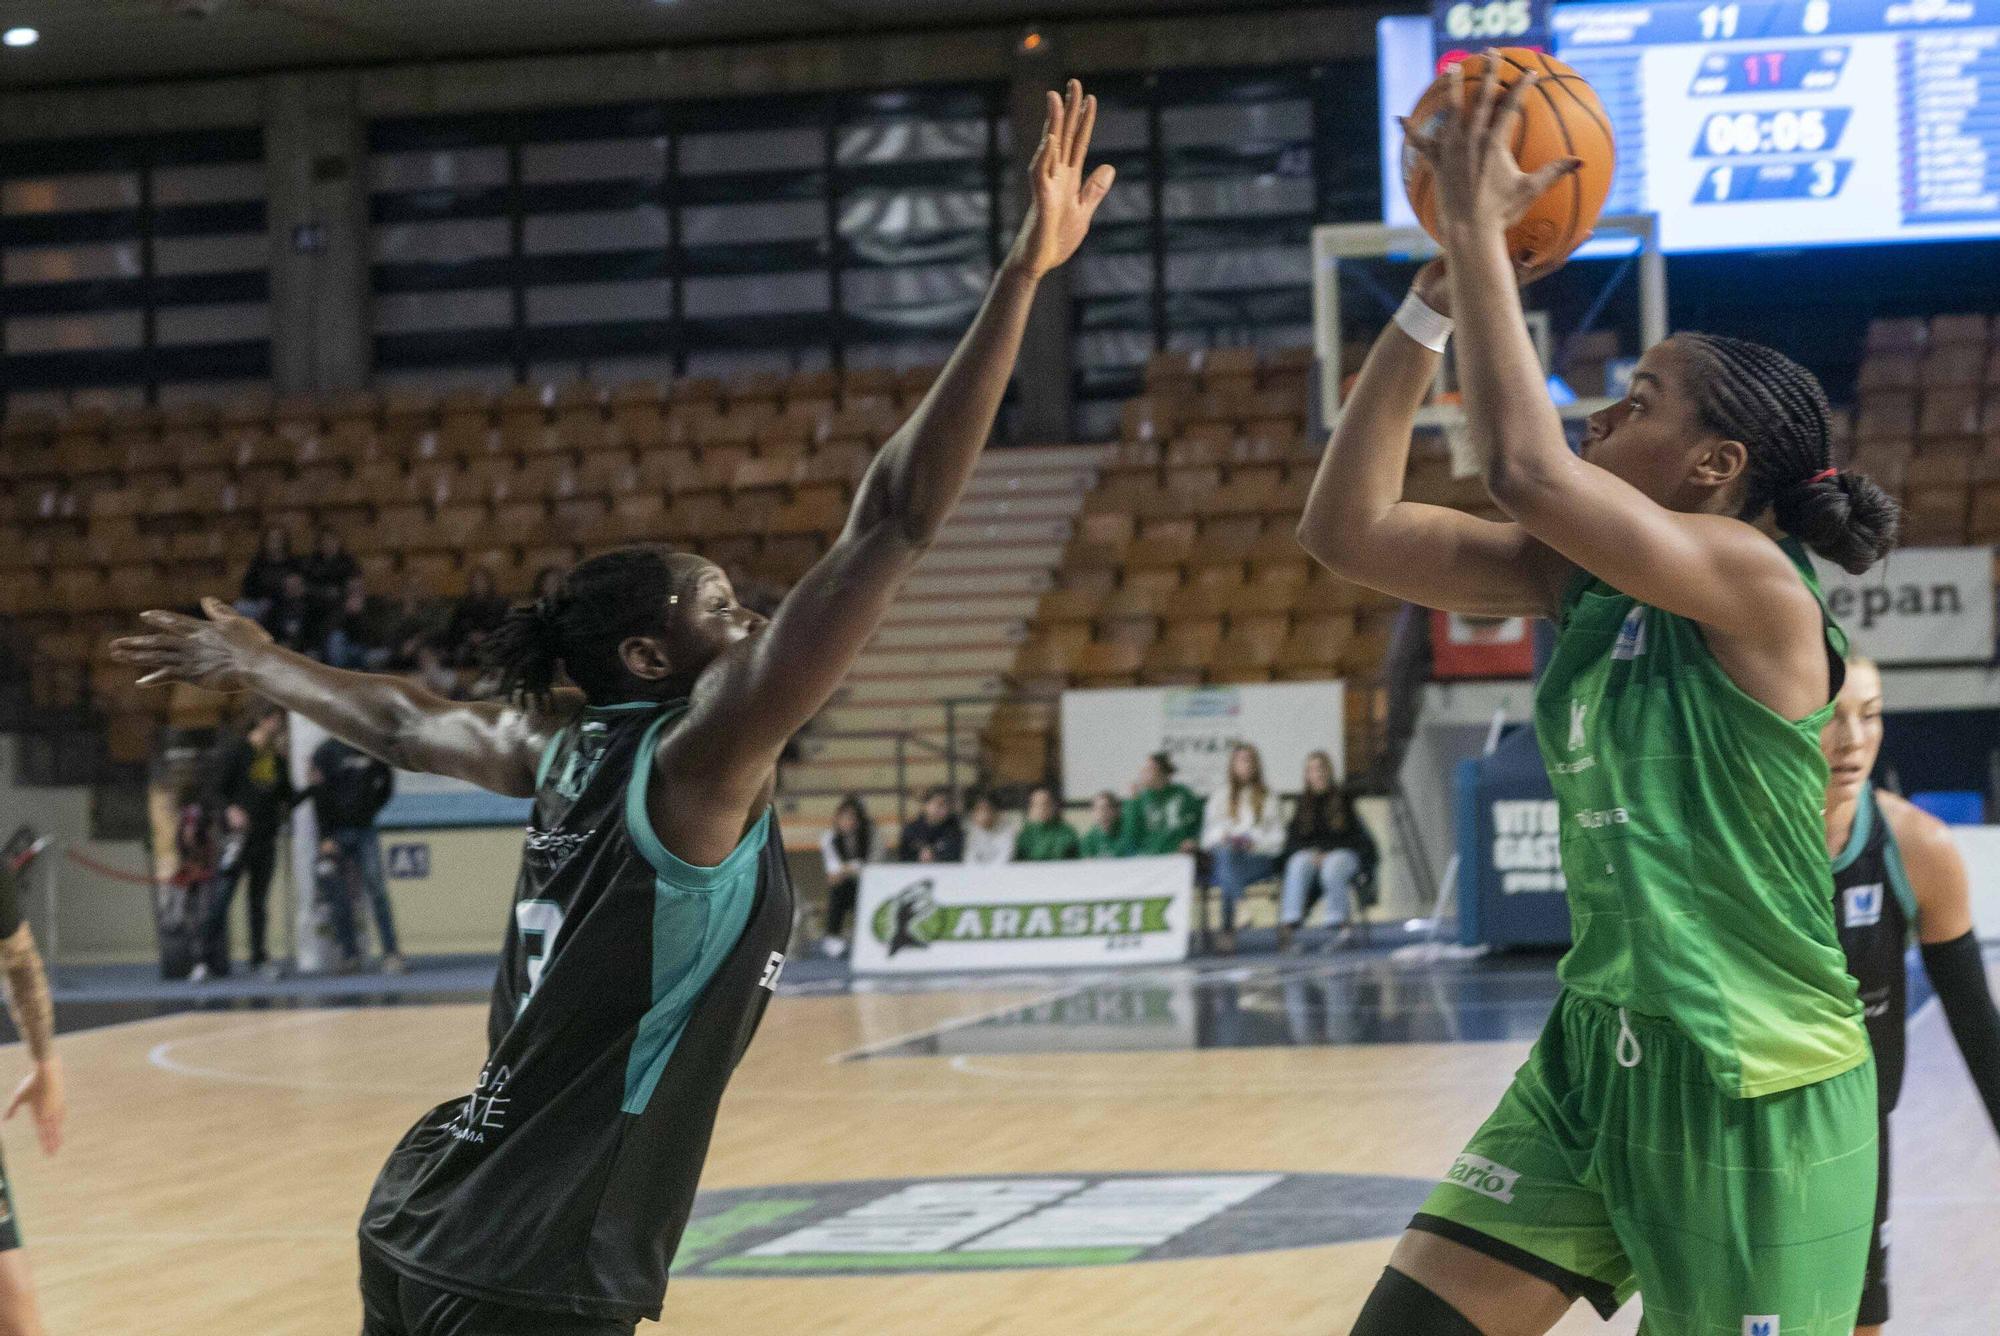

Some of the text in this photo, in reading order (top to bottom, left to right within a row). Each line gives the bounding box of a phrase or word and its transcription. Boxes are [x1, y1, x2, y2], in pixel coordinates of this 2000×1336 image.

[1447, 1, 1531, 39] 6:05
[1699, 4, 1740, 39] 11
[1743, 52, 1786, 86] 1T
[1707, 111, 1828, 154] 06:05
[1711, 160, 1836, 200] 1 3
[952, 902, 1145, 938] ARASKI
